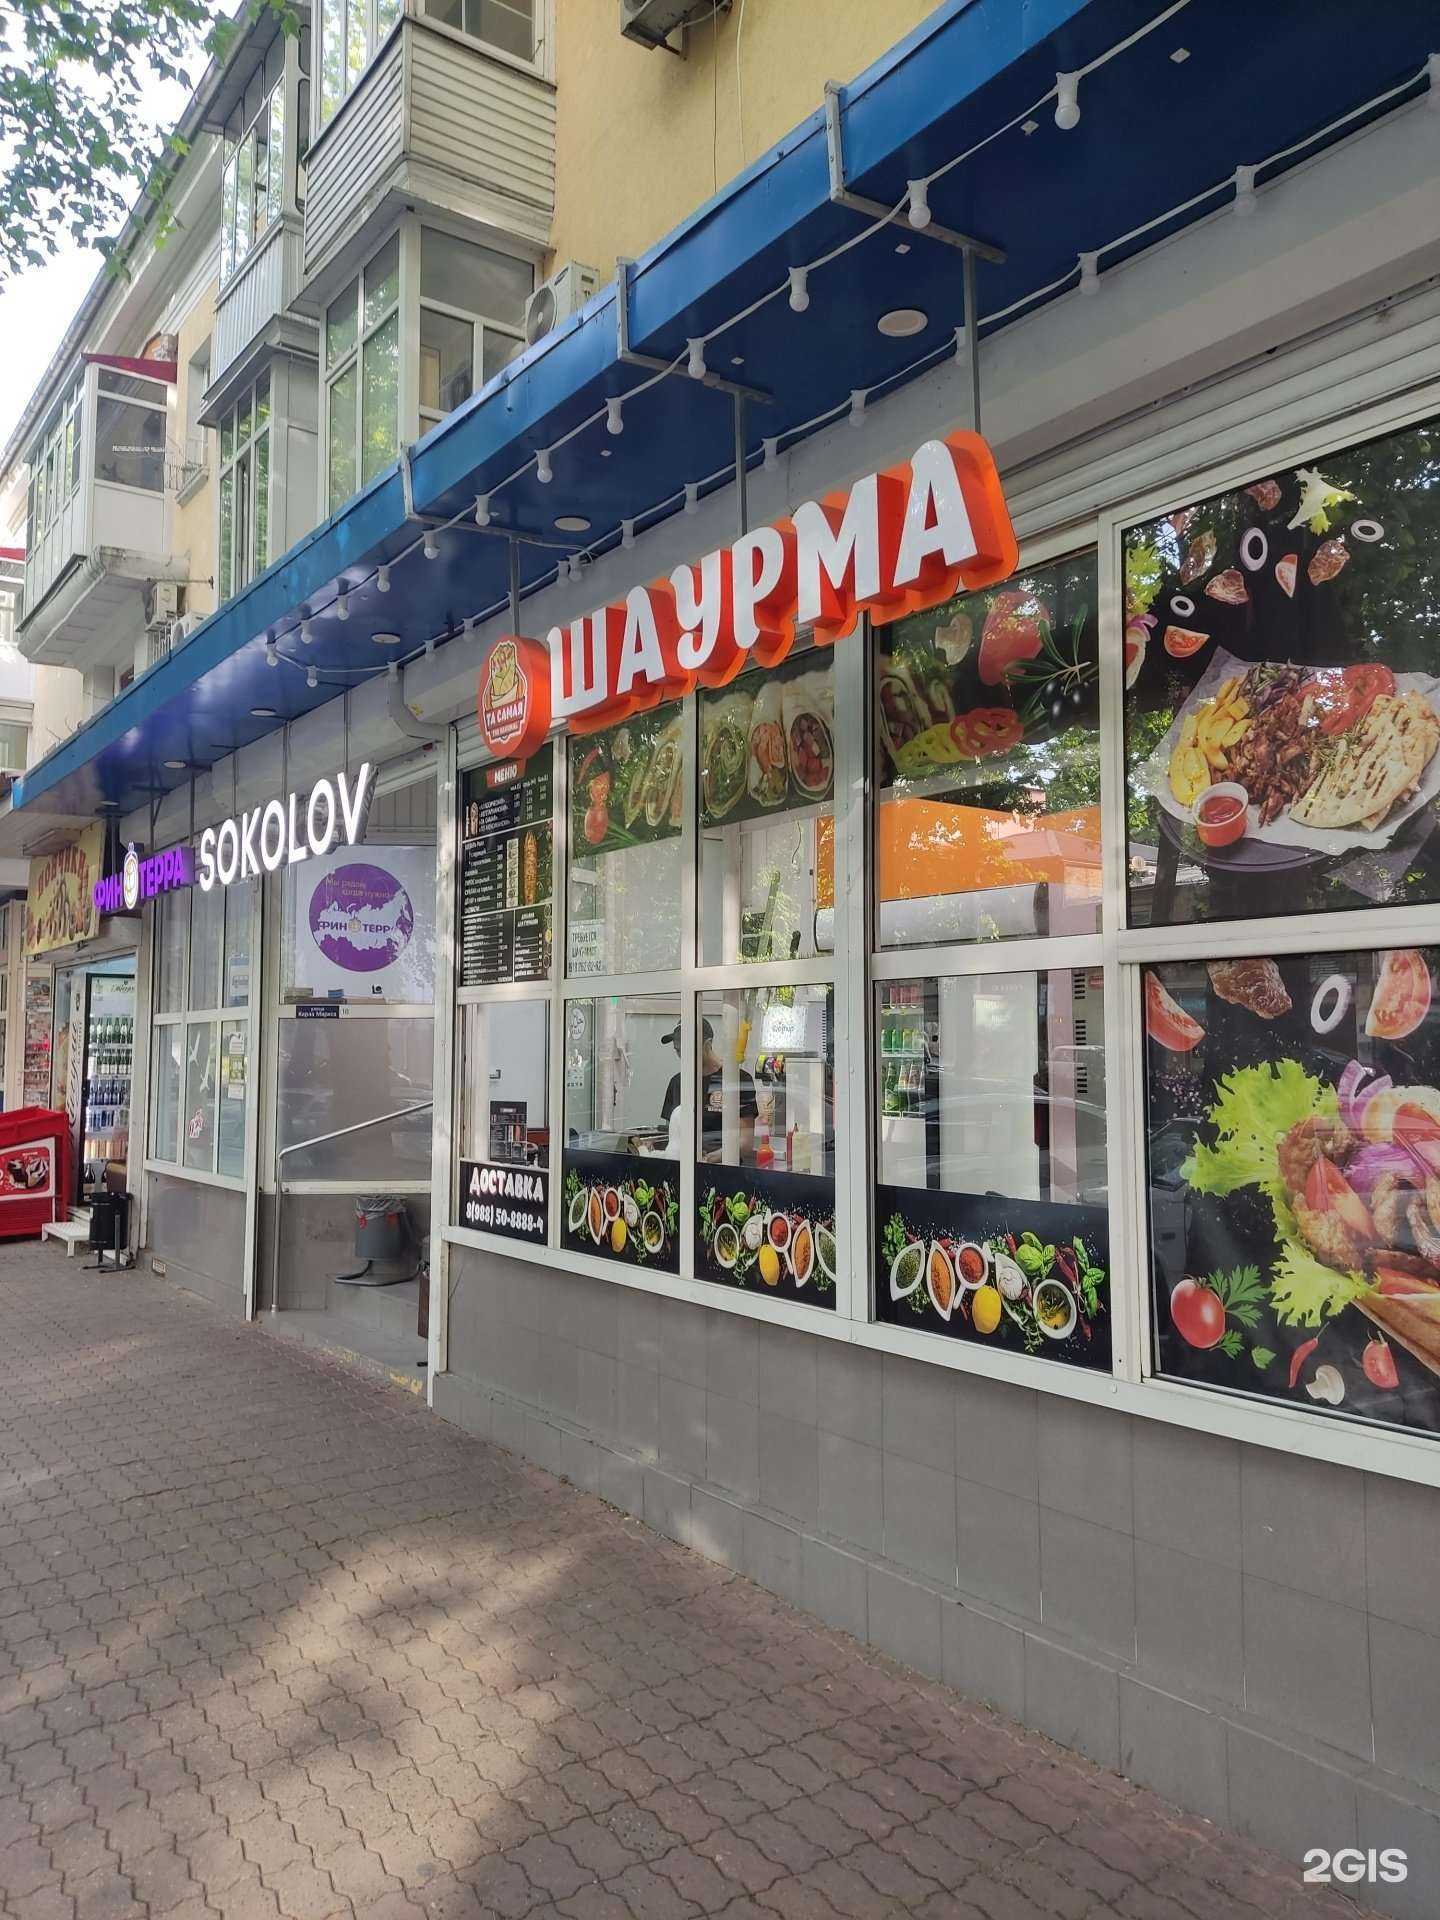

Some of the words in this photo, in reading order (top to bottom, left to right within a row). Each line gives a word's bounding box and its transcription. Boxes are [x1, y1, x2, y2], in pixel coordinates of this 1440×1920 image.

[548, 439, 979, 719] ШАУРМА
[494, 764, 517, 783] МЕНЮ
[199, 762, 371, 892] SOKOLOV
[93, 871, 123, 912] ФИН
[139, 847, 184, 900] ТЕРРА
[469, 1166, 544, 1202] ДОСТАВКА
